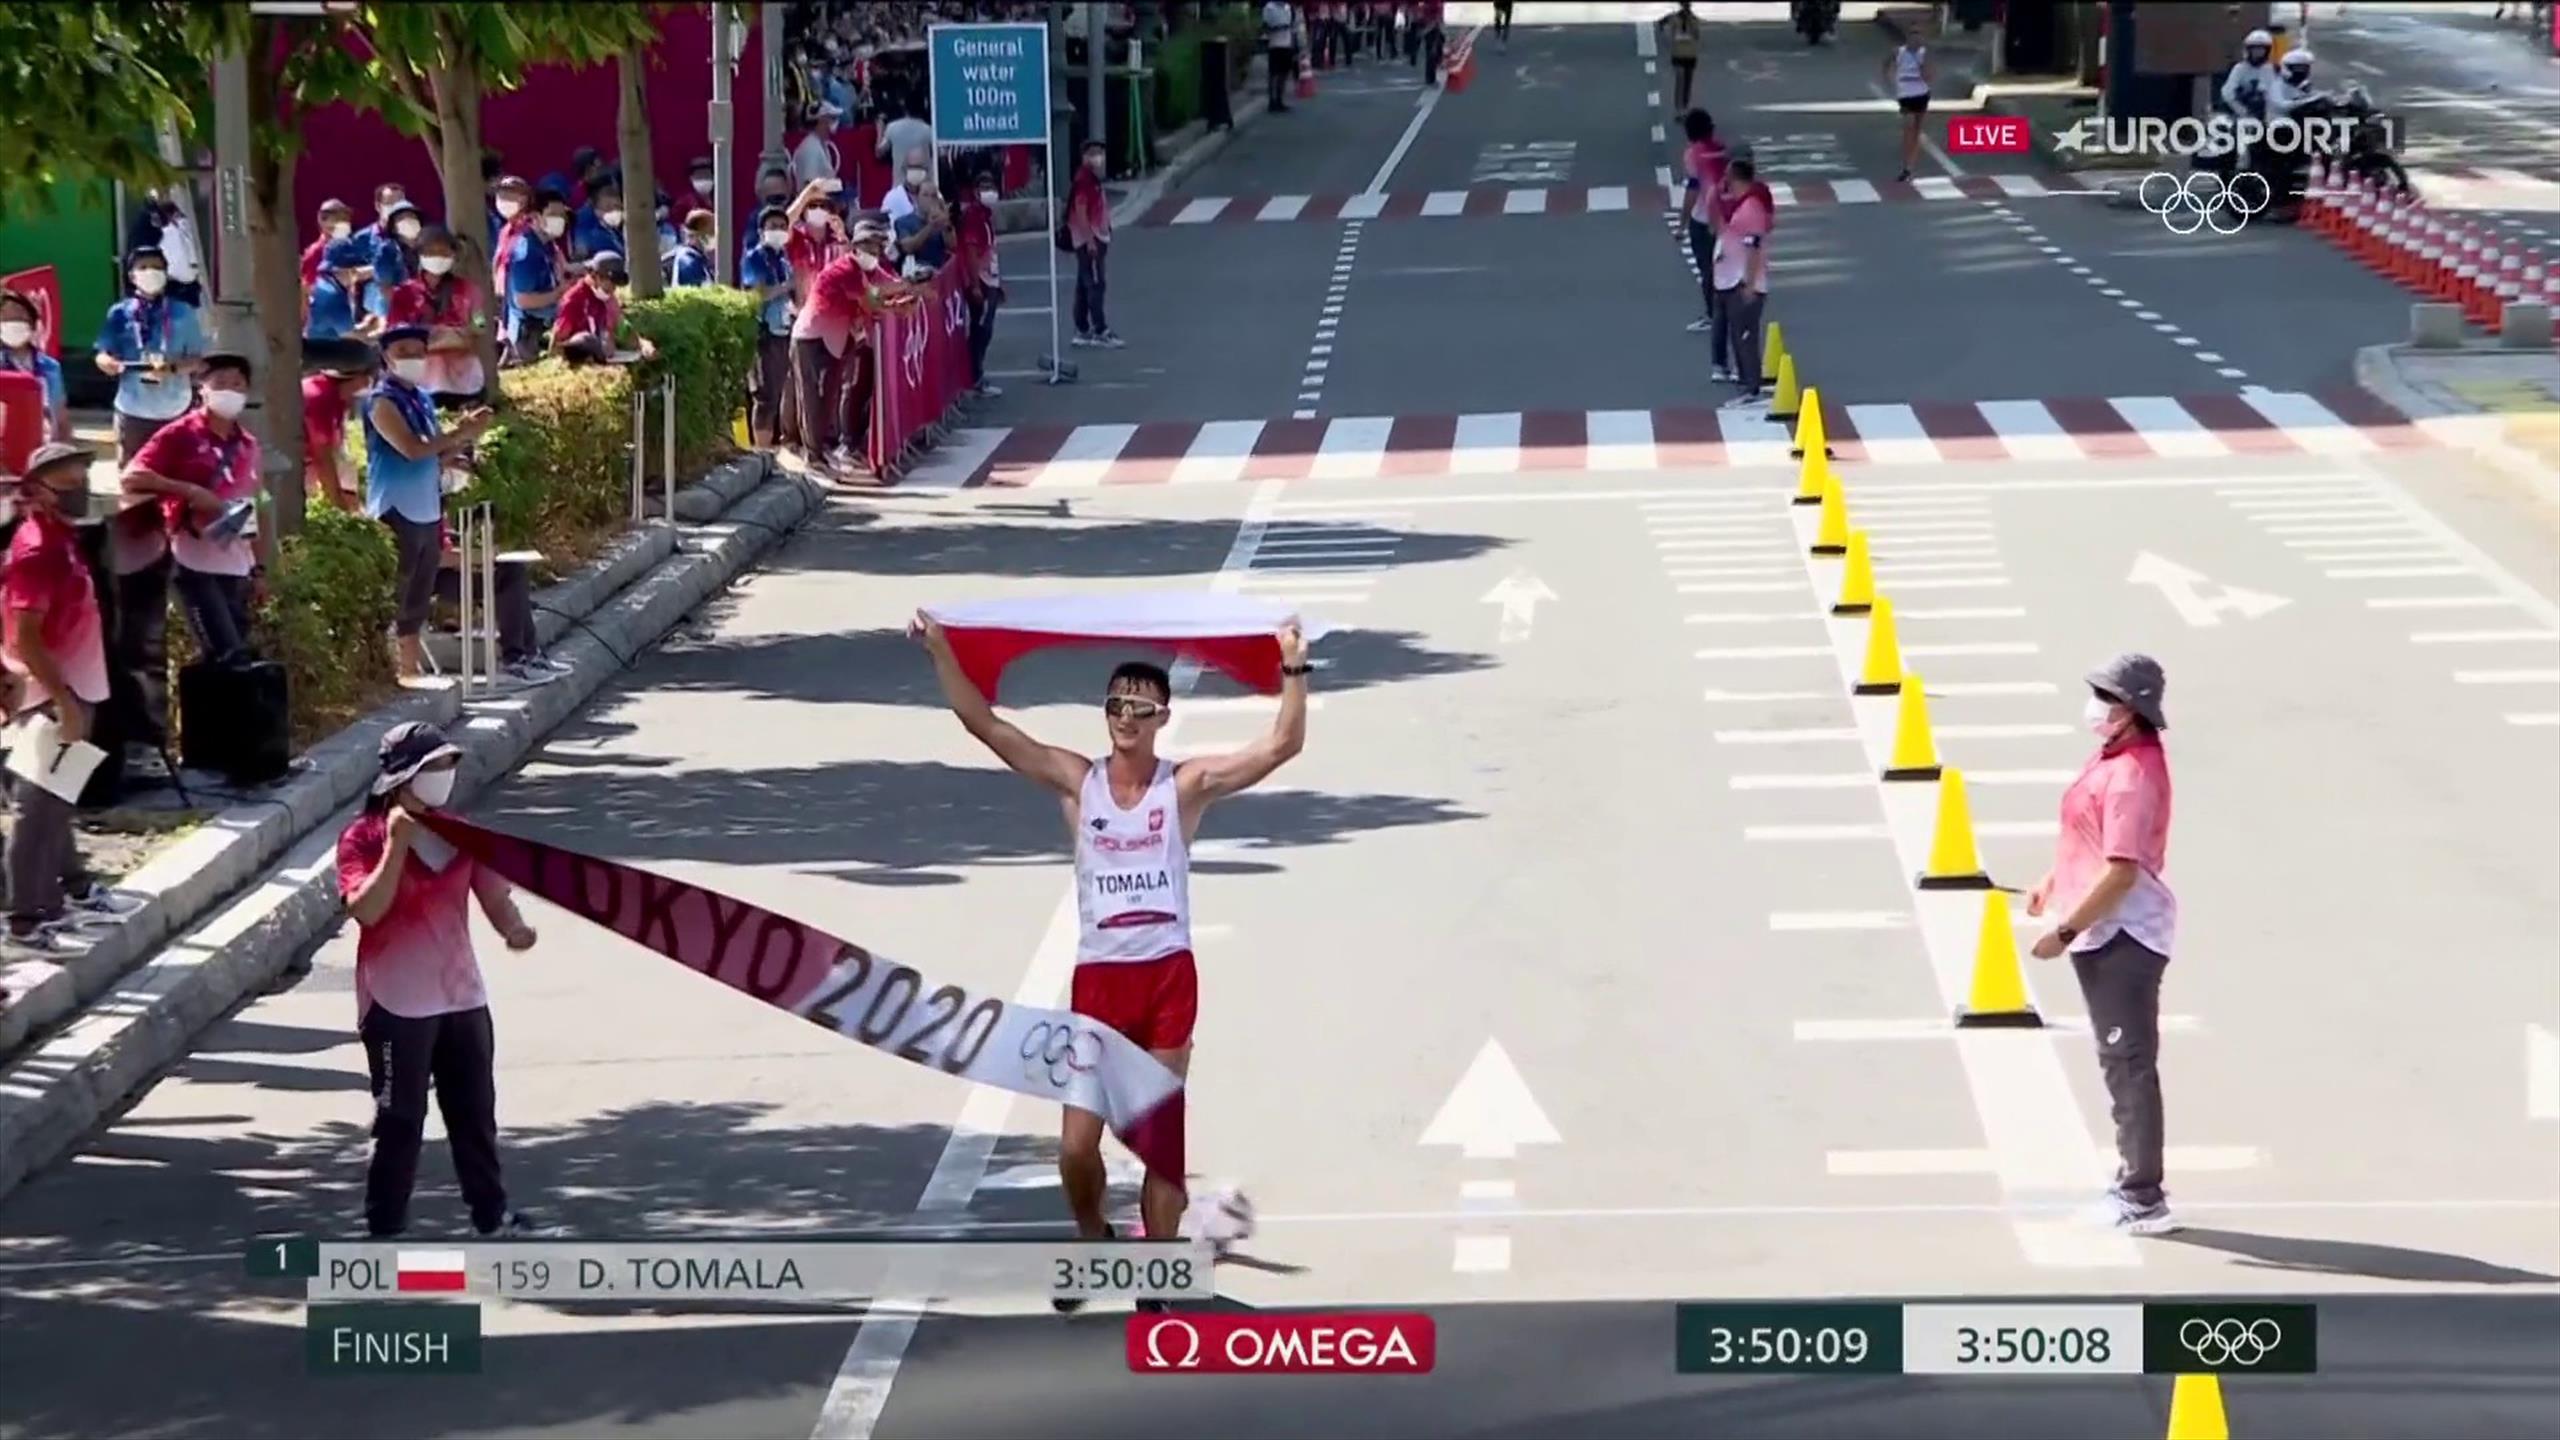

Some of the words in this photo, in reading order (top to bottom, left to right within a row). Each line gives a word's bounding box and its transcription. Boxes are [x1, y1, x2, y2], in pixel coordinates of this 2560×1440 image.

[953, 36, 1024, 58] General
[962, 63, 1015, 82] water
[967, 87, 1017, 107] 100m
[963, 112, 1019, 132] ahead
[1095, 869, 1170, 895] TOMALA
[518, 839, 804, 1001] TOKYO
[801, 943, 1004, 1075] 2020
